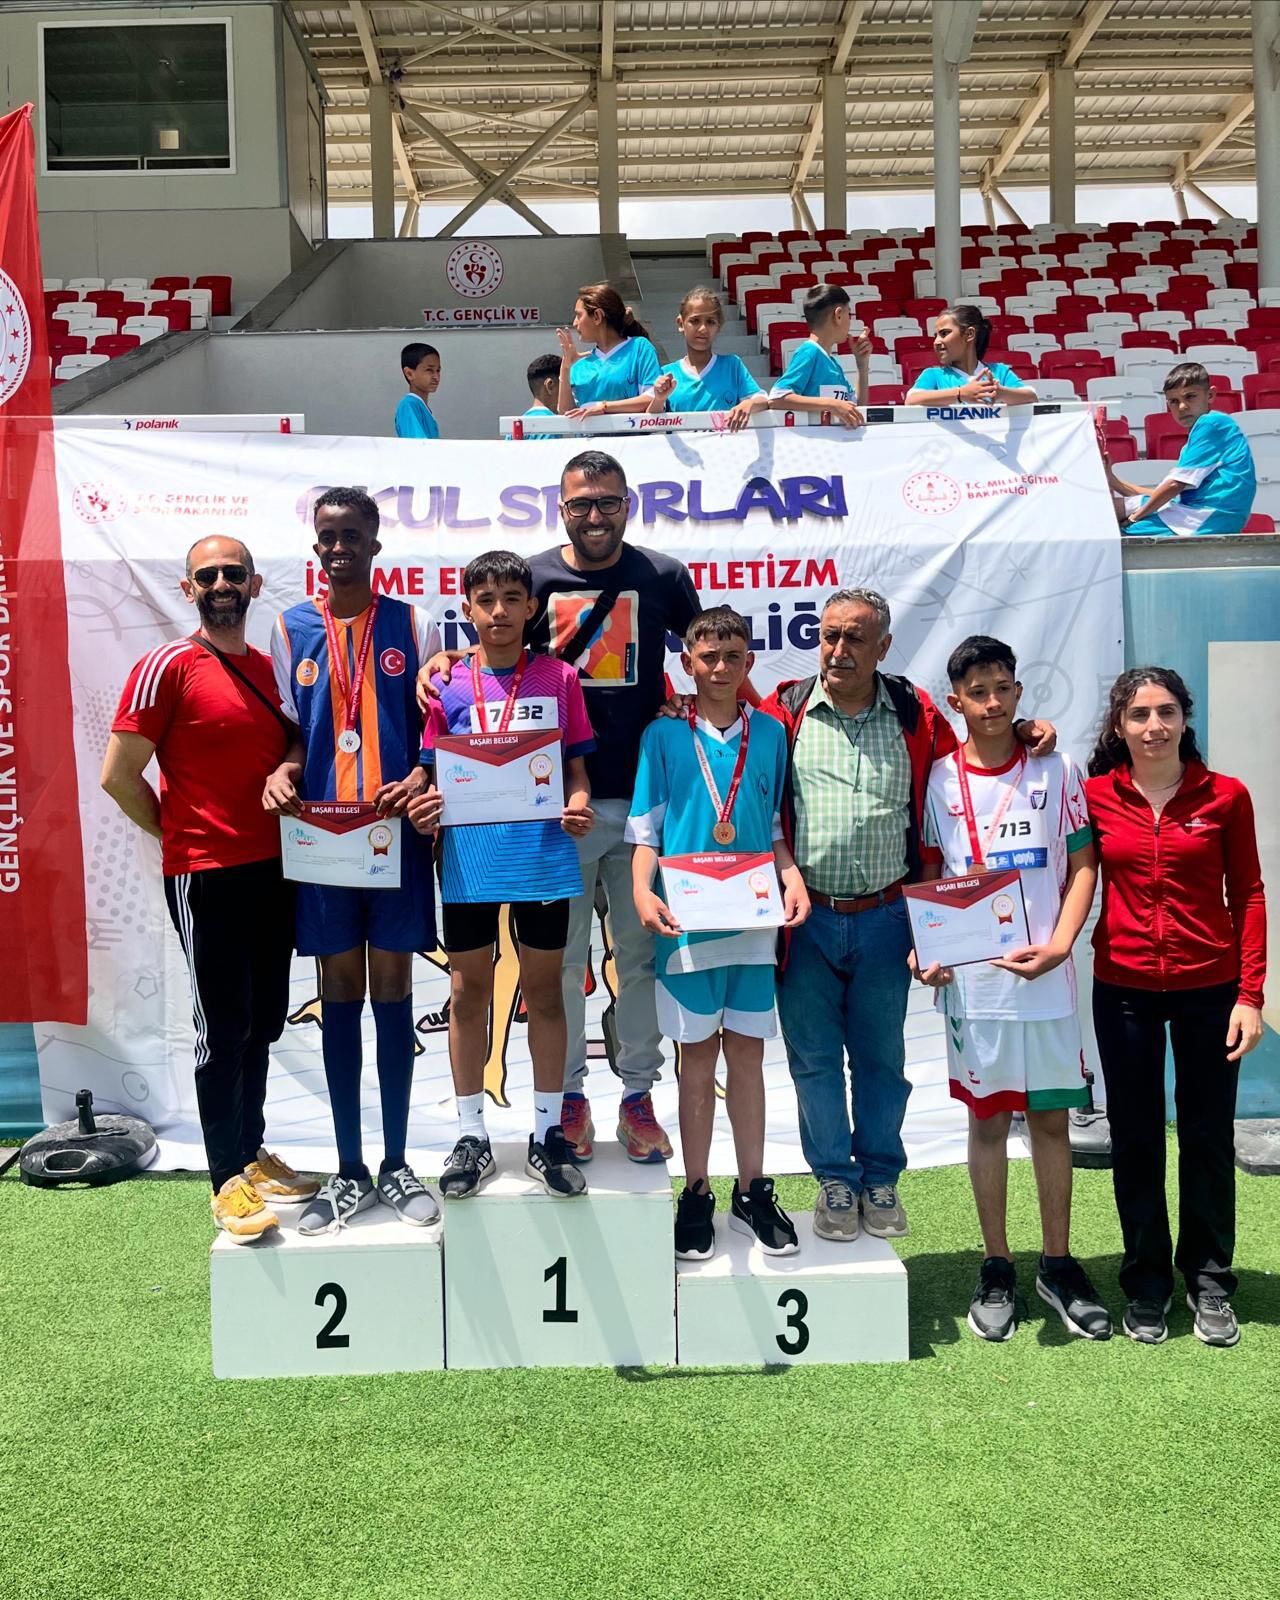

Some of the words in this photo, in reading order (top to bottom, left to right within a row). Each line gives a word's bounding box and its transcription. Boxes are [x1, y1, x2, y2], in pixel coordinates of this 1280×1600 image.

[424, 310, 449, 321] T.C.
[453, 306, 515, 322] GENÇLİK
[520, 309, 538, 320] VE
[926, 407, 1002, 421] POLANIK
[967, 487, 1028, 499] BAKANLIĞI
[688, 553, 838, 590] TLETİZM
[489, 705, 543, 723] 732
[469, 737, 492, 747] BAŞARI
[493, 735, 519, 745] BELGESİ
[311, 806, 334, 815] BAŞARI
[335, 806, 360, 814] BELGESİ
[984, 821, 1031, 838] 713
[935, 882, 957, 892] BAŞARI
[957, 878, 980, 889] BELGESİ
[541, 1256, 579, 1324] 1
[314, 1282, 351, 1350] 2
[775, 1288, 810, 1356] 3
